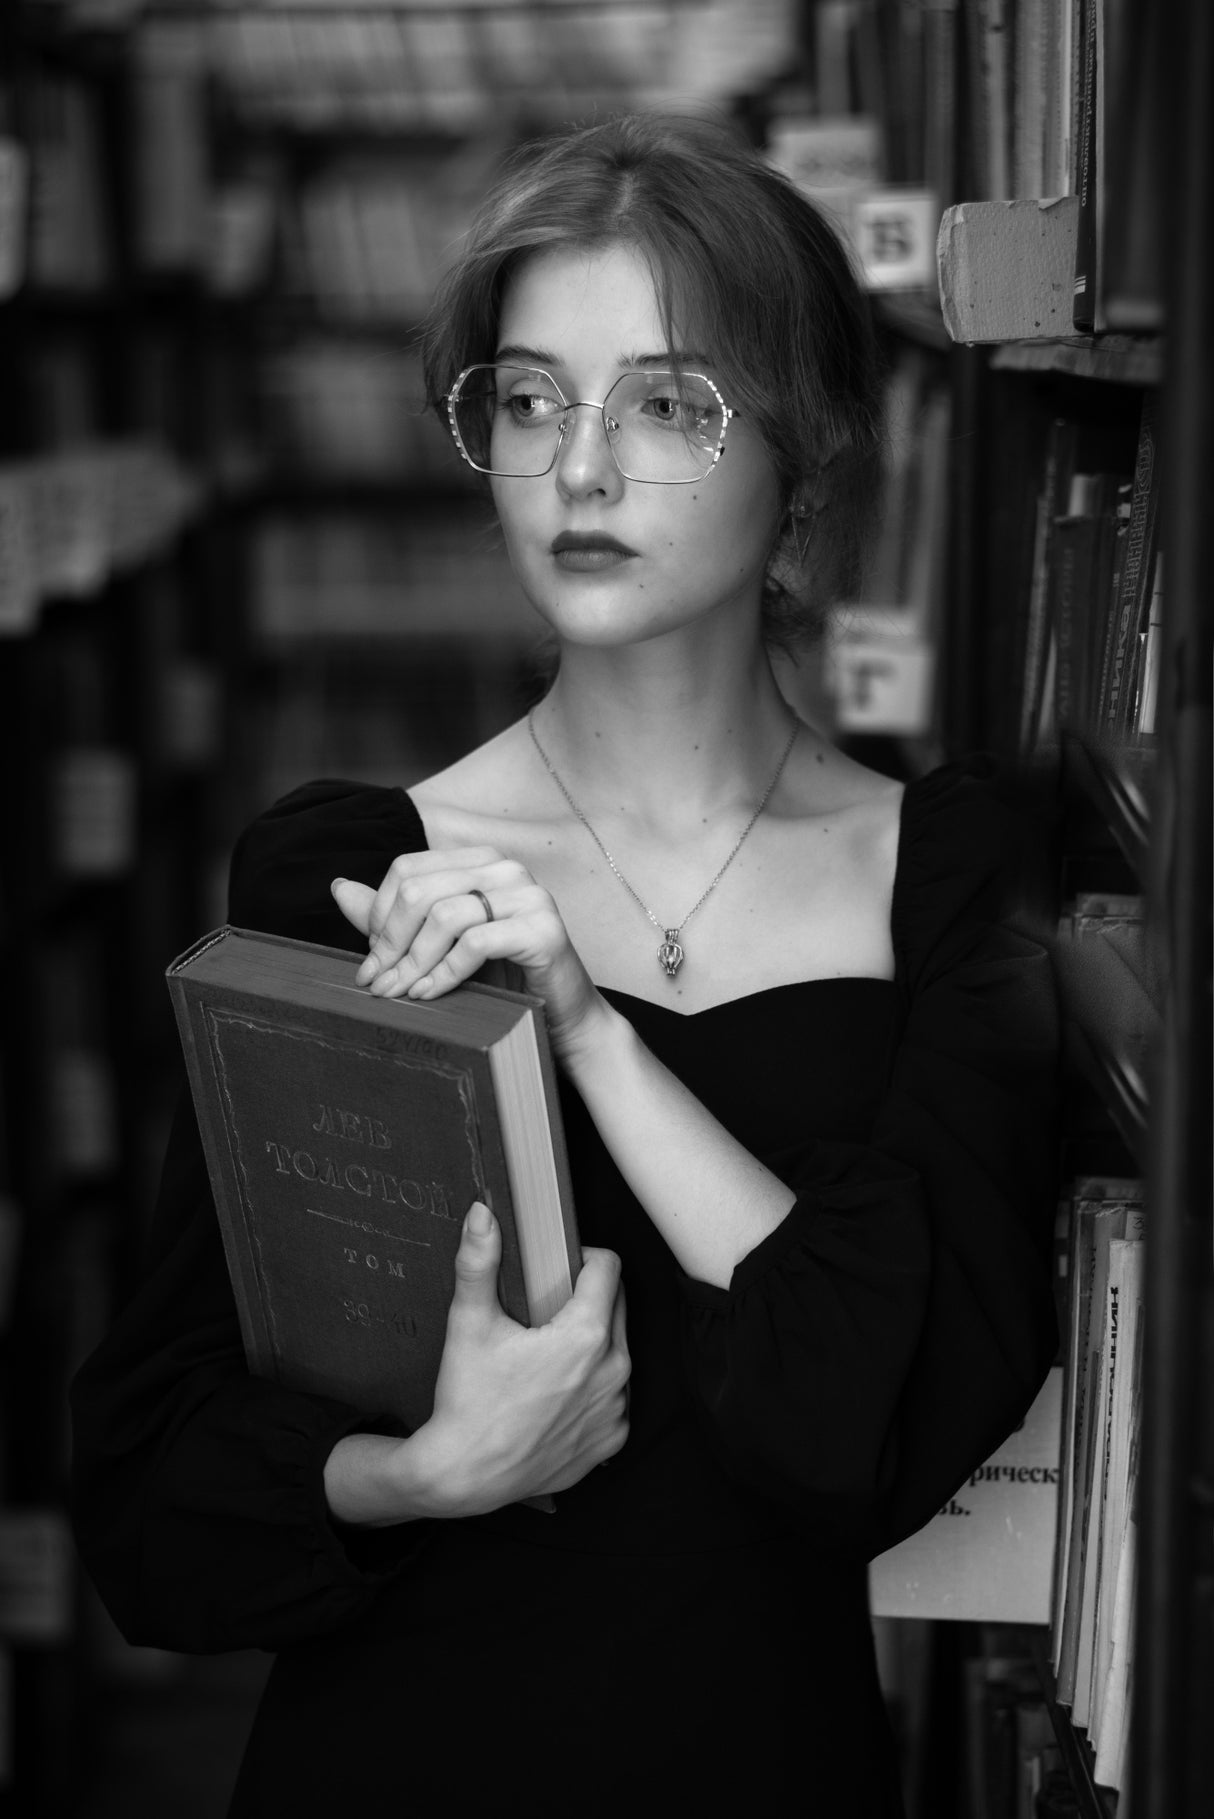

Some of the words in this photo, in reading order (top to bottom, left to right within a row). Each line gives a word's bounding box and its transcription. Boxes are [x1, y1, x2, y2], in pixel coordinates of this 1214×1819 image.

[312, 1104, 393, 1151] ЛЕВ
[266, 1140, 458, 1223] ТОЛСТОЙ
[343, 1248, 407, 1279] ТОМ
